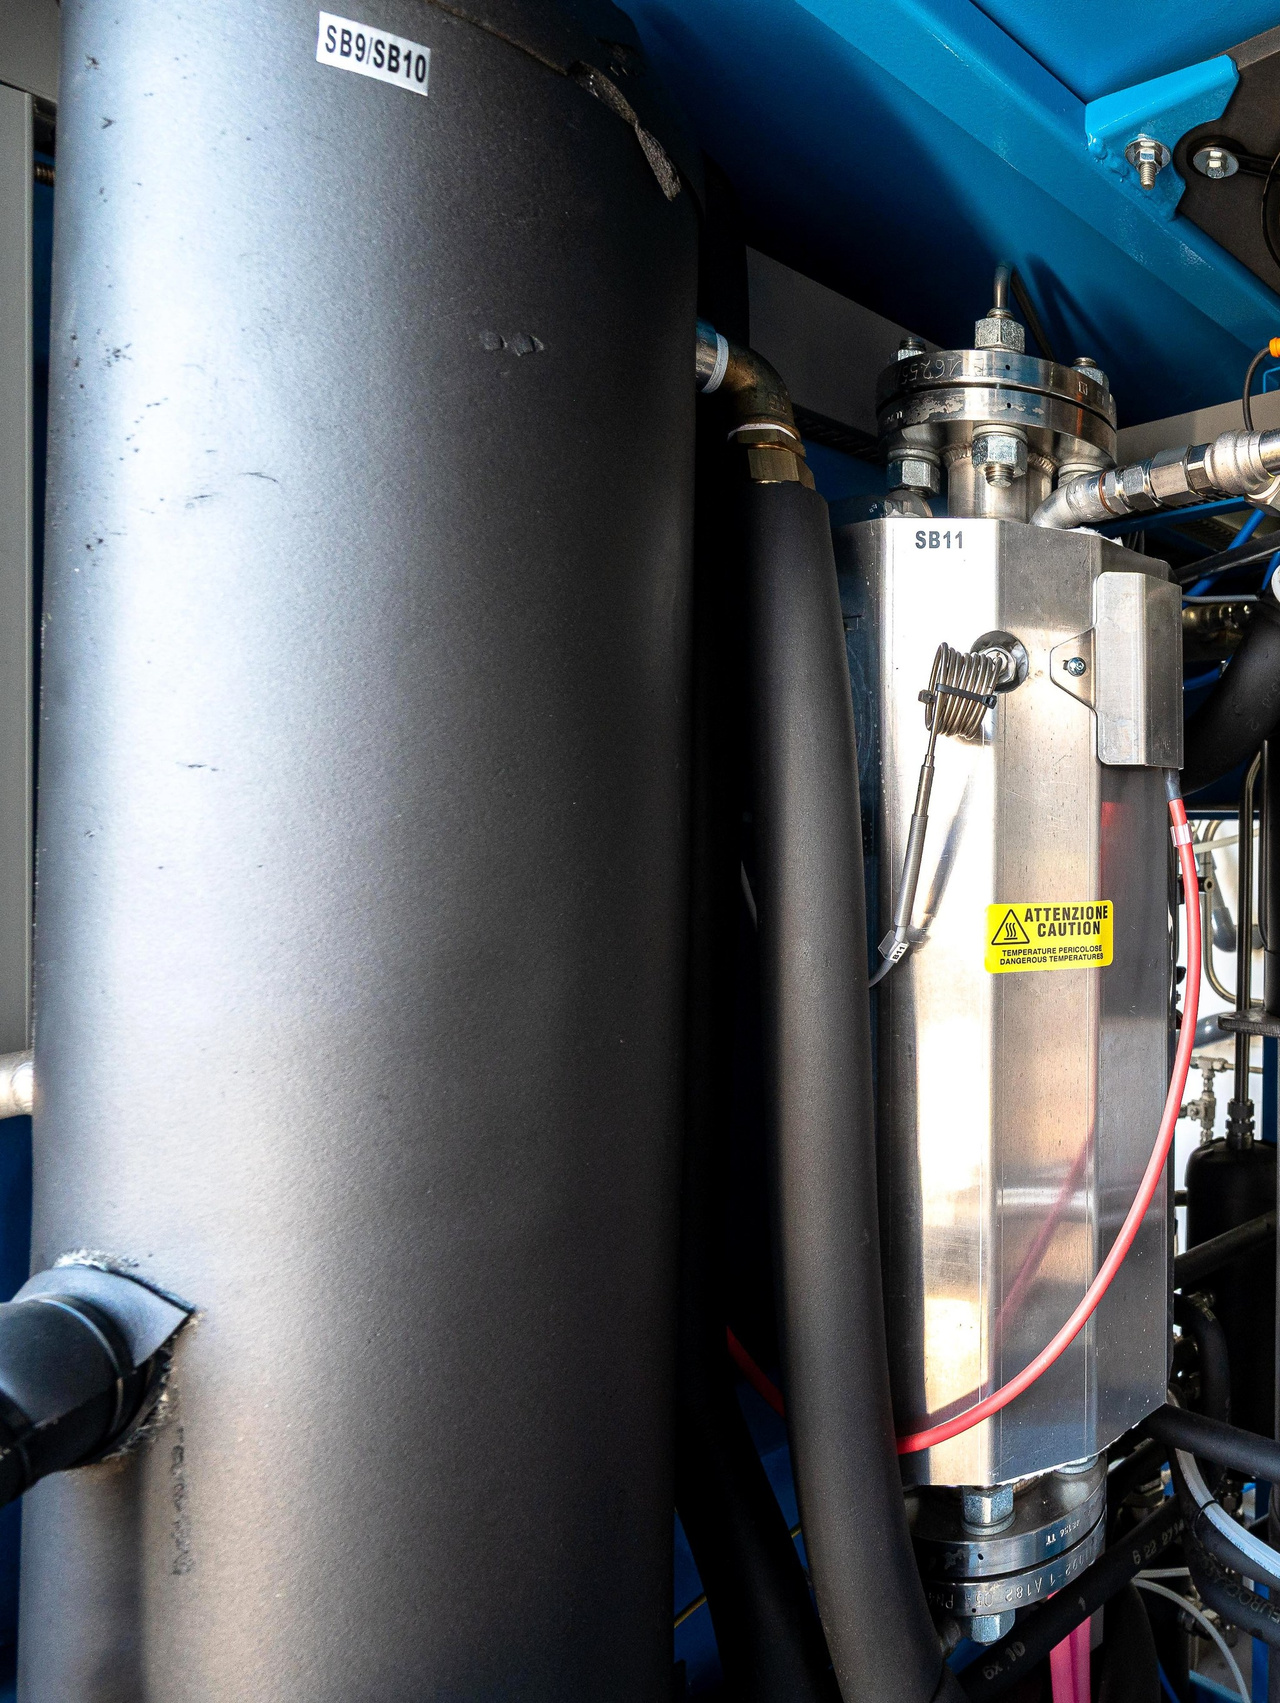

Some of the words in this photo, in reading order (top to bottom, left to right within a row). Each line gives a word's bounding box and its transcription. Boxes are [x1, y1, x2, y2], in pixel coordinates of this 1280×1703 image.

[324, 23, 427, 84] SB9/SB10
[914, 530, 964, 549] SB11
[1024, 905, 1108, 923] ATTENZIONE
[1037, 921, 1101, 938] CAUTION
[999, 955, 1048, 966] DANGEROUS
[1048, 952, 1104, 963] TEMPERATURES
[1002, 947, 1057, 957] TEMPERATURE
[1058, 944, 1103, 954] PERICOLOSE
